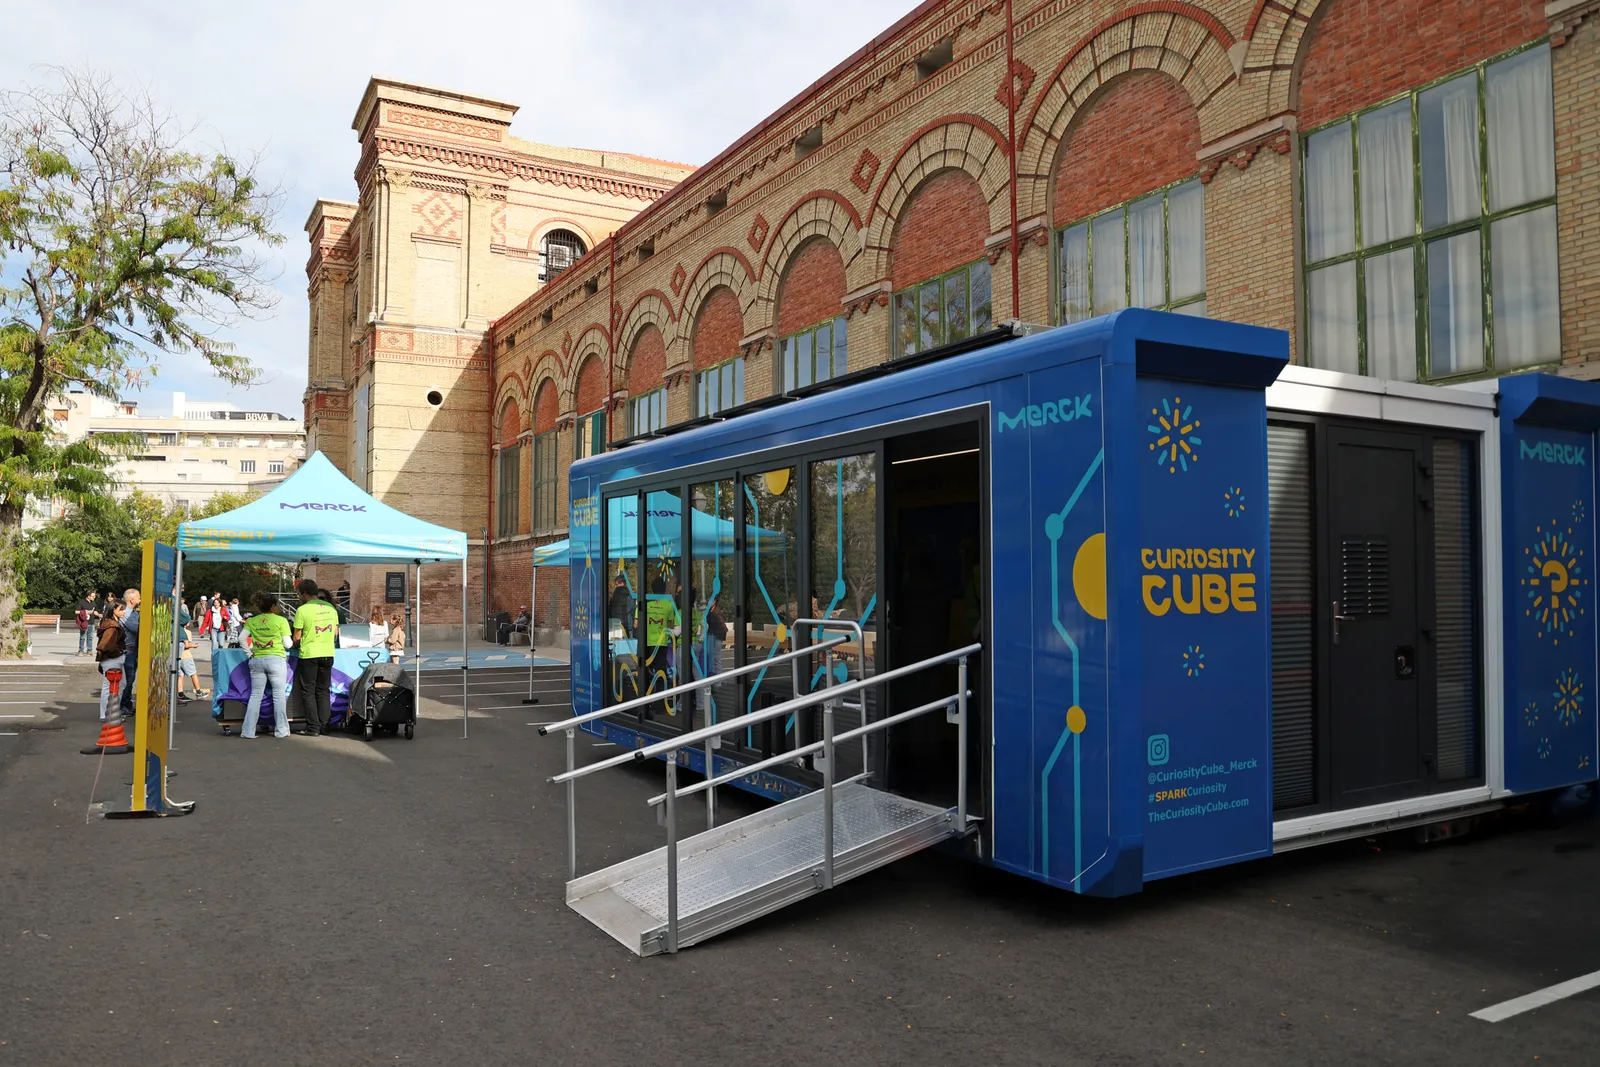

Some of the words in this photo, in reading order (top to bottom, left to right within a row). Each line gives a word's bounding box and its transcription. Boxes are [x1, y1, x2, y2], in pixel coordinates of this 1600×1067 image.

[245, 412, 269, 420] BBVA
[998, 394, 1092, 432] MERCK
[1520, 439, 1585, 466] MERCK
[279, 502, 367, 512] MERCK
[573, 507, 599, 527] CUBE
[1141, 548, 1256, 569] CURIOSITY
[1141, 573, 1257, 616] CUBE
[1148, 758, 1257, 784] @CuriosityCube_Merck
[1148, 783, 1227, 803] #SPARKCuriosity
[1148, 798, 1249, 822] TheCuriosityCube.com
